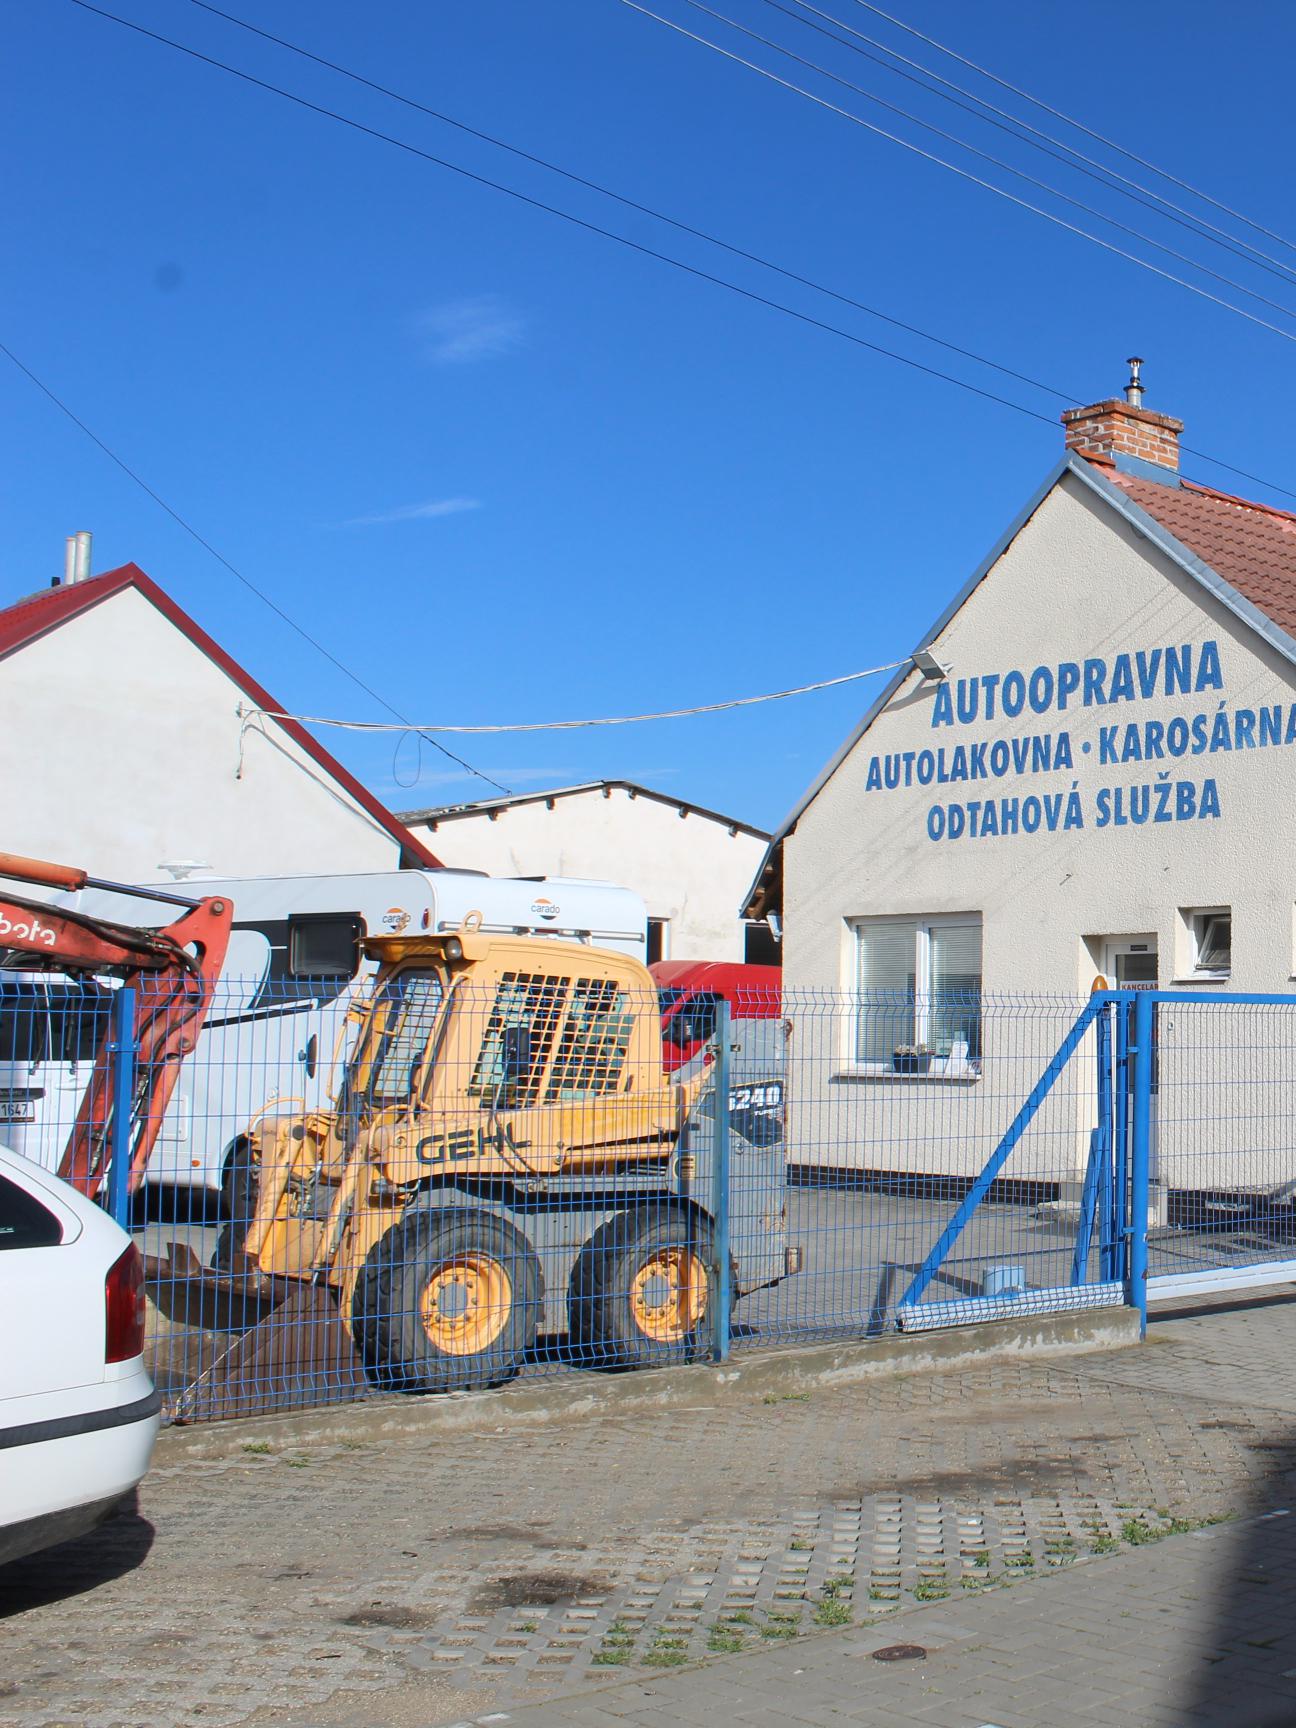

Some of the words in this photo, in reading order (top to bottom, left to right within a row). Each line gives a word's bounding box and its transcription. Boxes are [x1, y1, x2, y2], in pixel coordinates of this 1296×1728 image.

[932, 641, 1224, 727] AUTOOPRAVNA
[866, 732, 1073, 790] AUTOLAKOVNA
[928, 781, 1083, 840] ODTAHOVÁ
[1097, 771, 1220, 826] SLUŽBA
[530, 904, 560, 914] carado
[416, 1121, 532, 1165] GEHL
